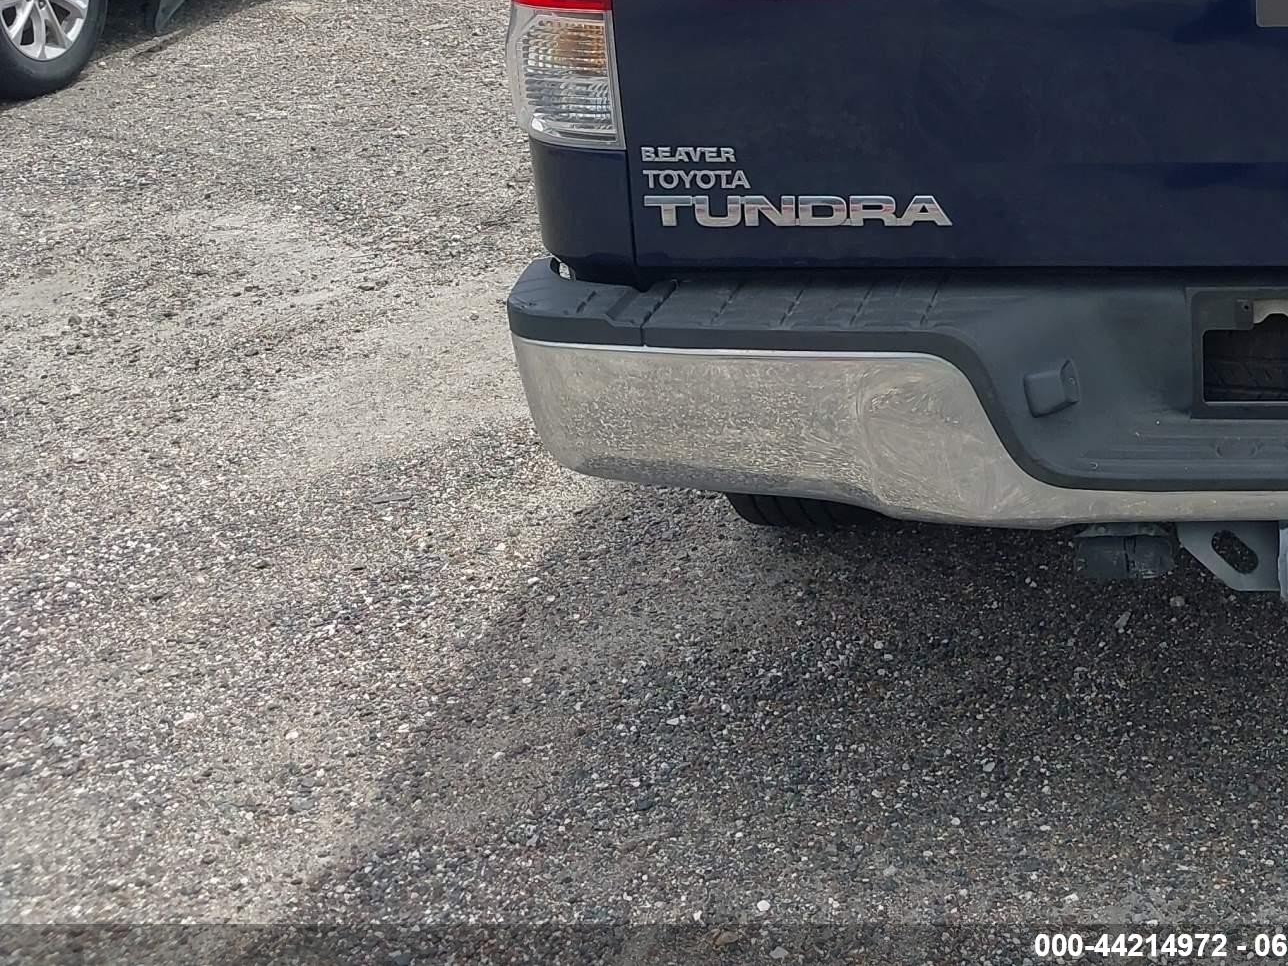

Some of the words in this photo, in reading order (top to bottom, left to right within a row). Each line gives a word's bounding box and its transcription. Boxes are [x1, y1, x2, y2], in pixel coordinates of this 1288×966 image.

[641, 146, 736, 162] BEAVER
[642, 170, 751, 189] TOYOTA
[644, 195, 952, 227] TUNDRA
